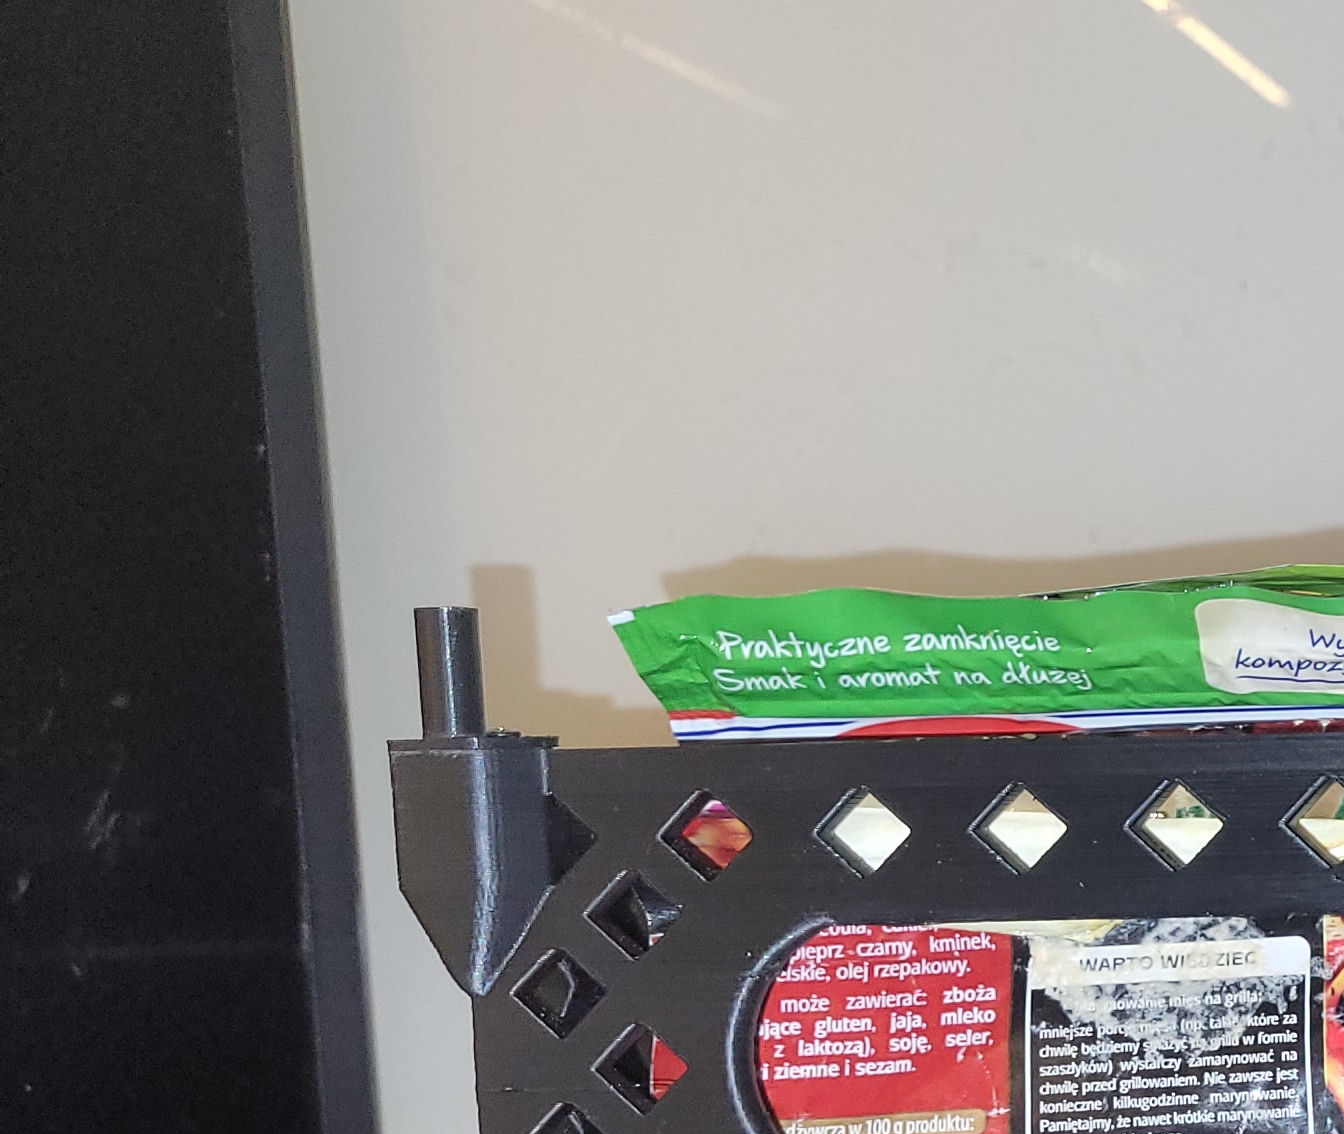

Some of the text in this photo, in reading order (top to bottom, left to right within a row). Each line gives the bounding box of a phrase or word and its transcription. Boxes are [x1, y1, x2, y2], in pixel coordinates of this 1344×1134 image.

[717, 624, 1062, 668] Praktyczne zamknięcie
[713, 662, 1093, 692] Smak i aromat na dłużej
[929, 931, 997, 954] kminek,
[836, 961, 869, 983] olej
[873, 957, 971, 981] rzepakowy.
[780, 994, 830, 1014] może
[942, 984, 997, 1005] zboża
[813, 1016, 877, 1038] gluten,
[889, 1011, 927, 1034] jaja,
[940, 1007, 997, 1026] mleko
[1282, 1013, 1298, 1025] za
[773, 1045, 786, 1058] z
[889, 1032, 933, 1054] soję,
[945, 1029, 994, 1048] seler,
[1038, 1044, 1079, 1059] chwilę
[1242, 1034, 1256, 1046] w
[1257, 1029, 1298, 1044] formie
[1281, 1050, 1298, 1062] na
[772, 1062, 840, 1080] ziemne
[844, 1059, 851, 1077] i
[855, 1058, 917, 1077] sezam.
[1038, 1067, 1300, 1096] chwilę przed grillowaniem. Nie zawsze jest
[1112, 1092, 1200, 1112] kilkugodzinne
[1039, 1105, 1300, 1134] Pamiętajmy, że nawet krótkie marynowanie
